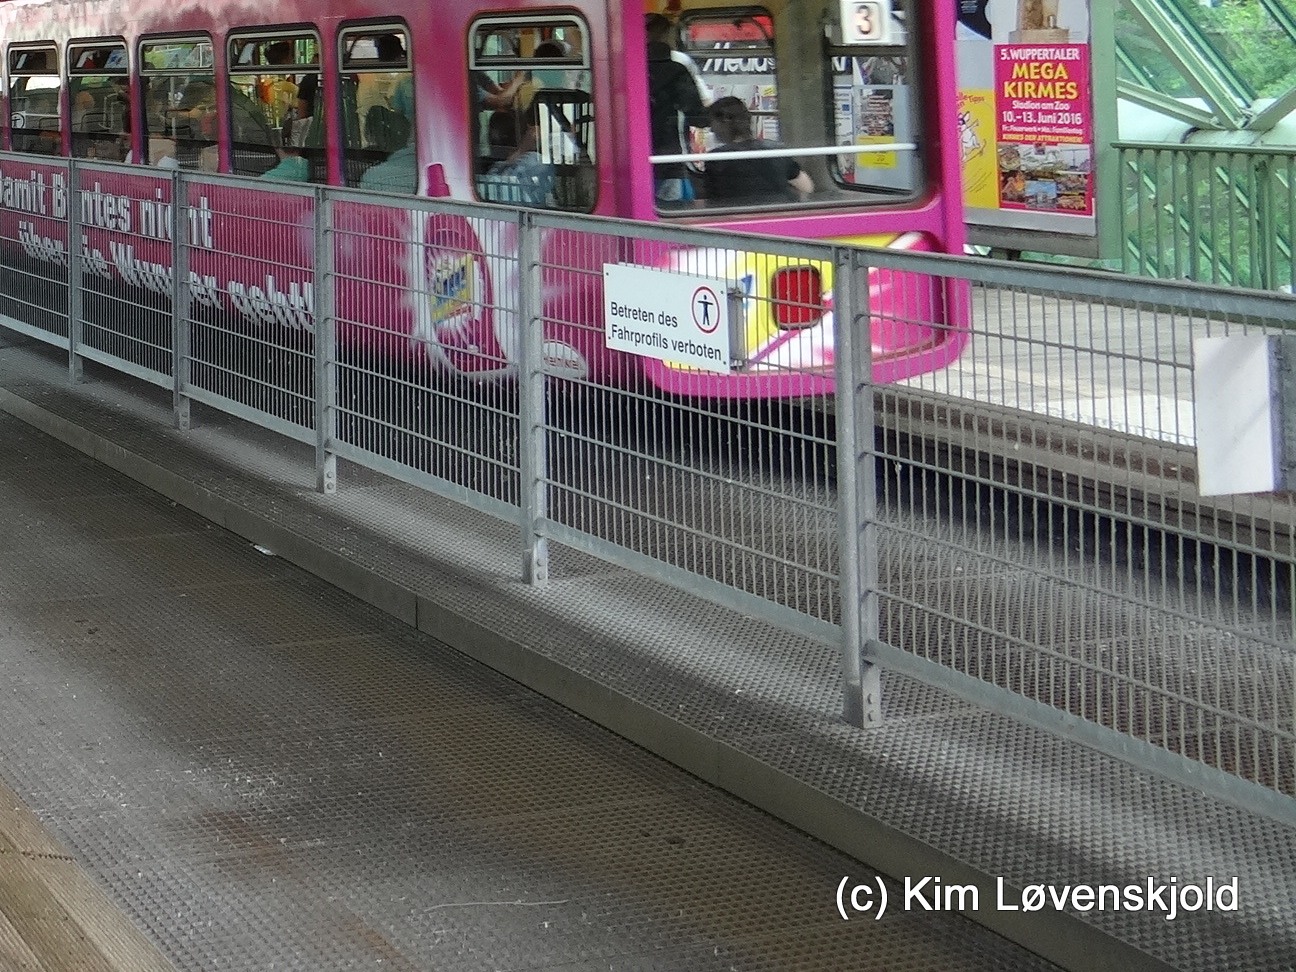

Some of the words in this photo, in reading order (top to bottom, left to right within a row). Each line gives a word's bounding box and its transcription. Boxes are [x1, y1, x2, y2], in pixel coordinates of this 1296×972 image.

[855, 5, 870, 35] 3
[1012, 62, 1068, 79] MEGA
[1004, 81, 1079, 99] KIRMES
[1012, 100, 1040, 110] Stadion
[1054, 101, 1070, 110] Zoo
[1037, 113, 1057, 123] Juni
[1058, 113, 1082, 125] 2016
[52, 171, 131, 233] Bntes
[610, 301, 655, 324] Betreten
[657, 311, 678, 328] des
[611, 324, 669, 350] Fahrprofils
[671, 339, 722, 361] verboten
